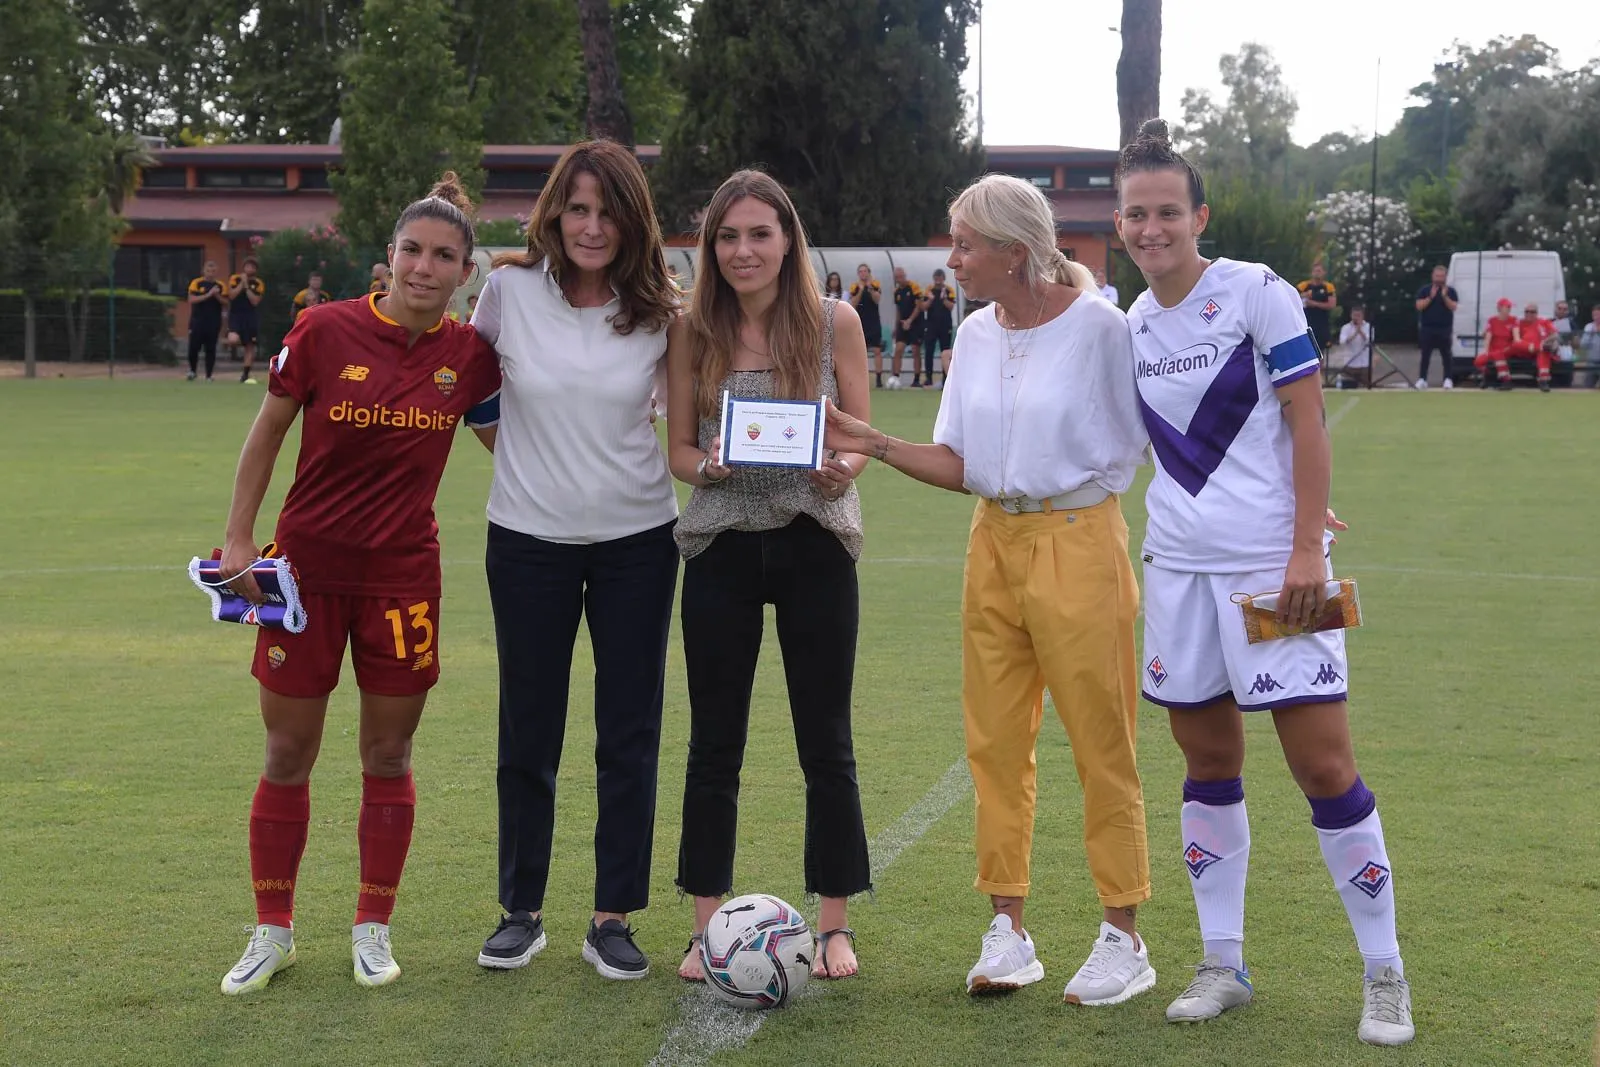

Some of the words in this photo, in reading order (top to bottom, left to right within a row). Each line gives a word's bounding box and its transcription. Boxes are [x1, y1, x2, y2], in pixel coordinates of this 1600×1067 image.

[1136, 353, 1208, 379] Mediacom
[329, 400, 455, 430] digitalbits
[385, 601, 433, 659] 13
